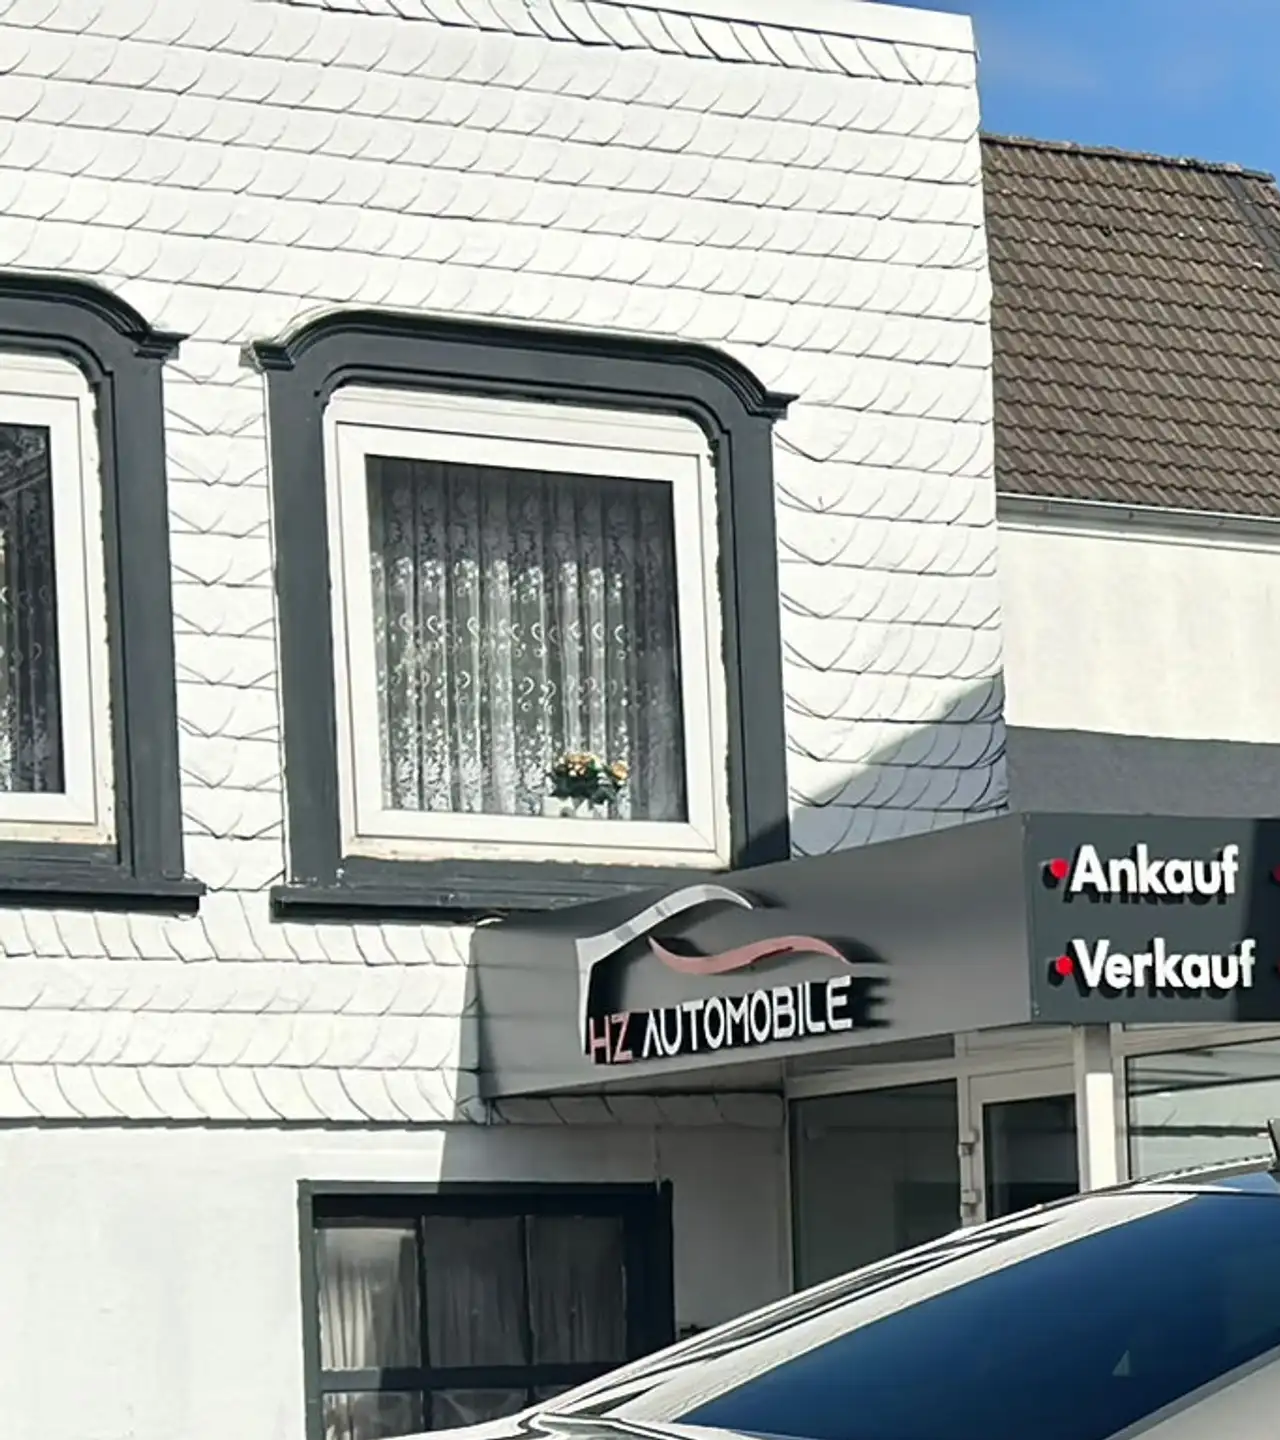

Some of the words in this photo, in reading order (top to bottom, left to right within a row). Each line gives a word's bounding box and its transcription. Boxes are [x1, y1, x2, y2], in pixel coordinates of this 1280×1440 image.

[1070, 843, 1239, 894] Ankauf
[1071, 937, 1256, 989] Verkauf
[588, 1011, 633, 1064] HZ
[642, 974, 853, 1058] AUTOMOBILE
